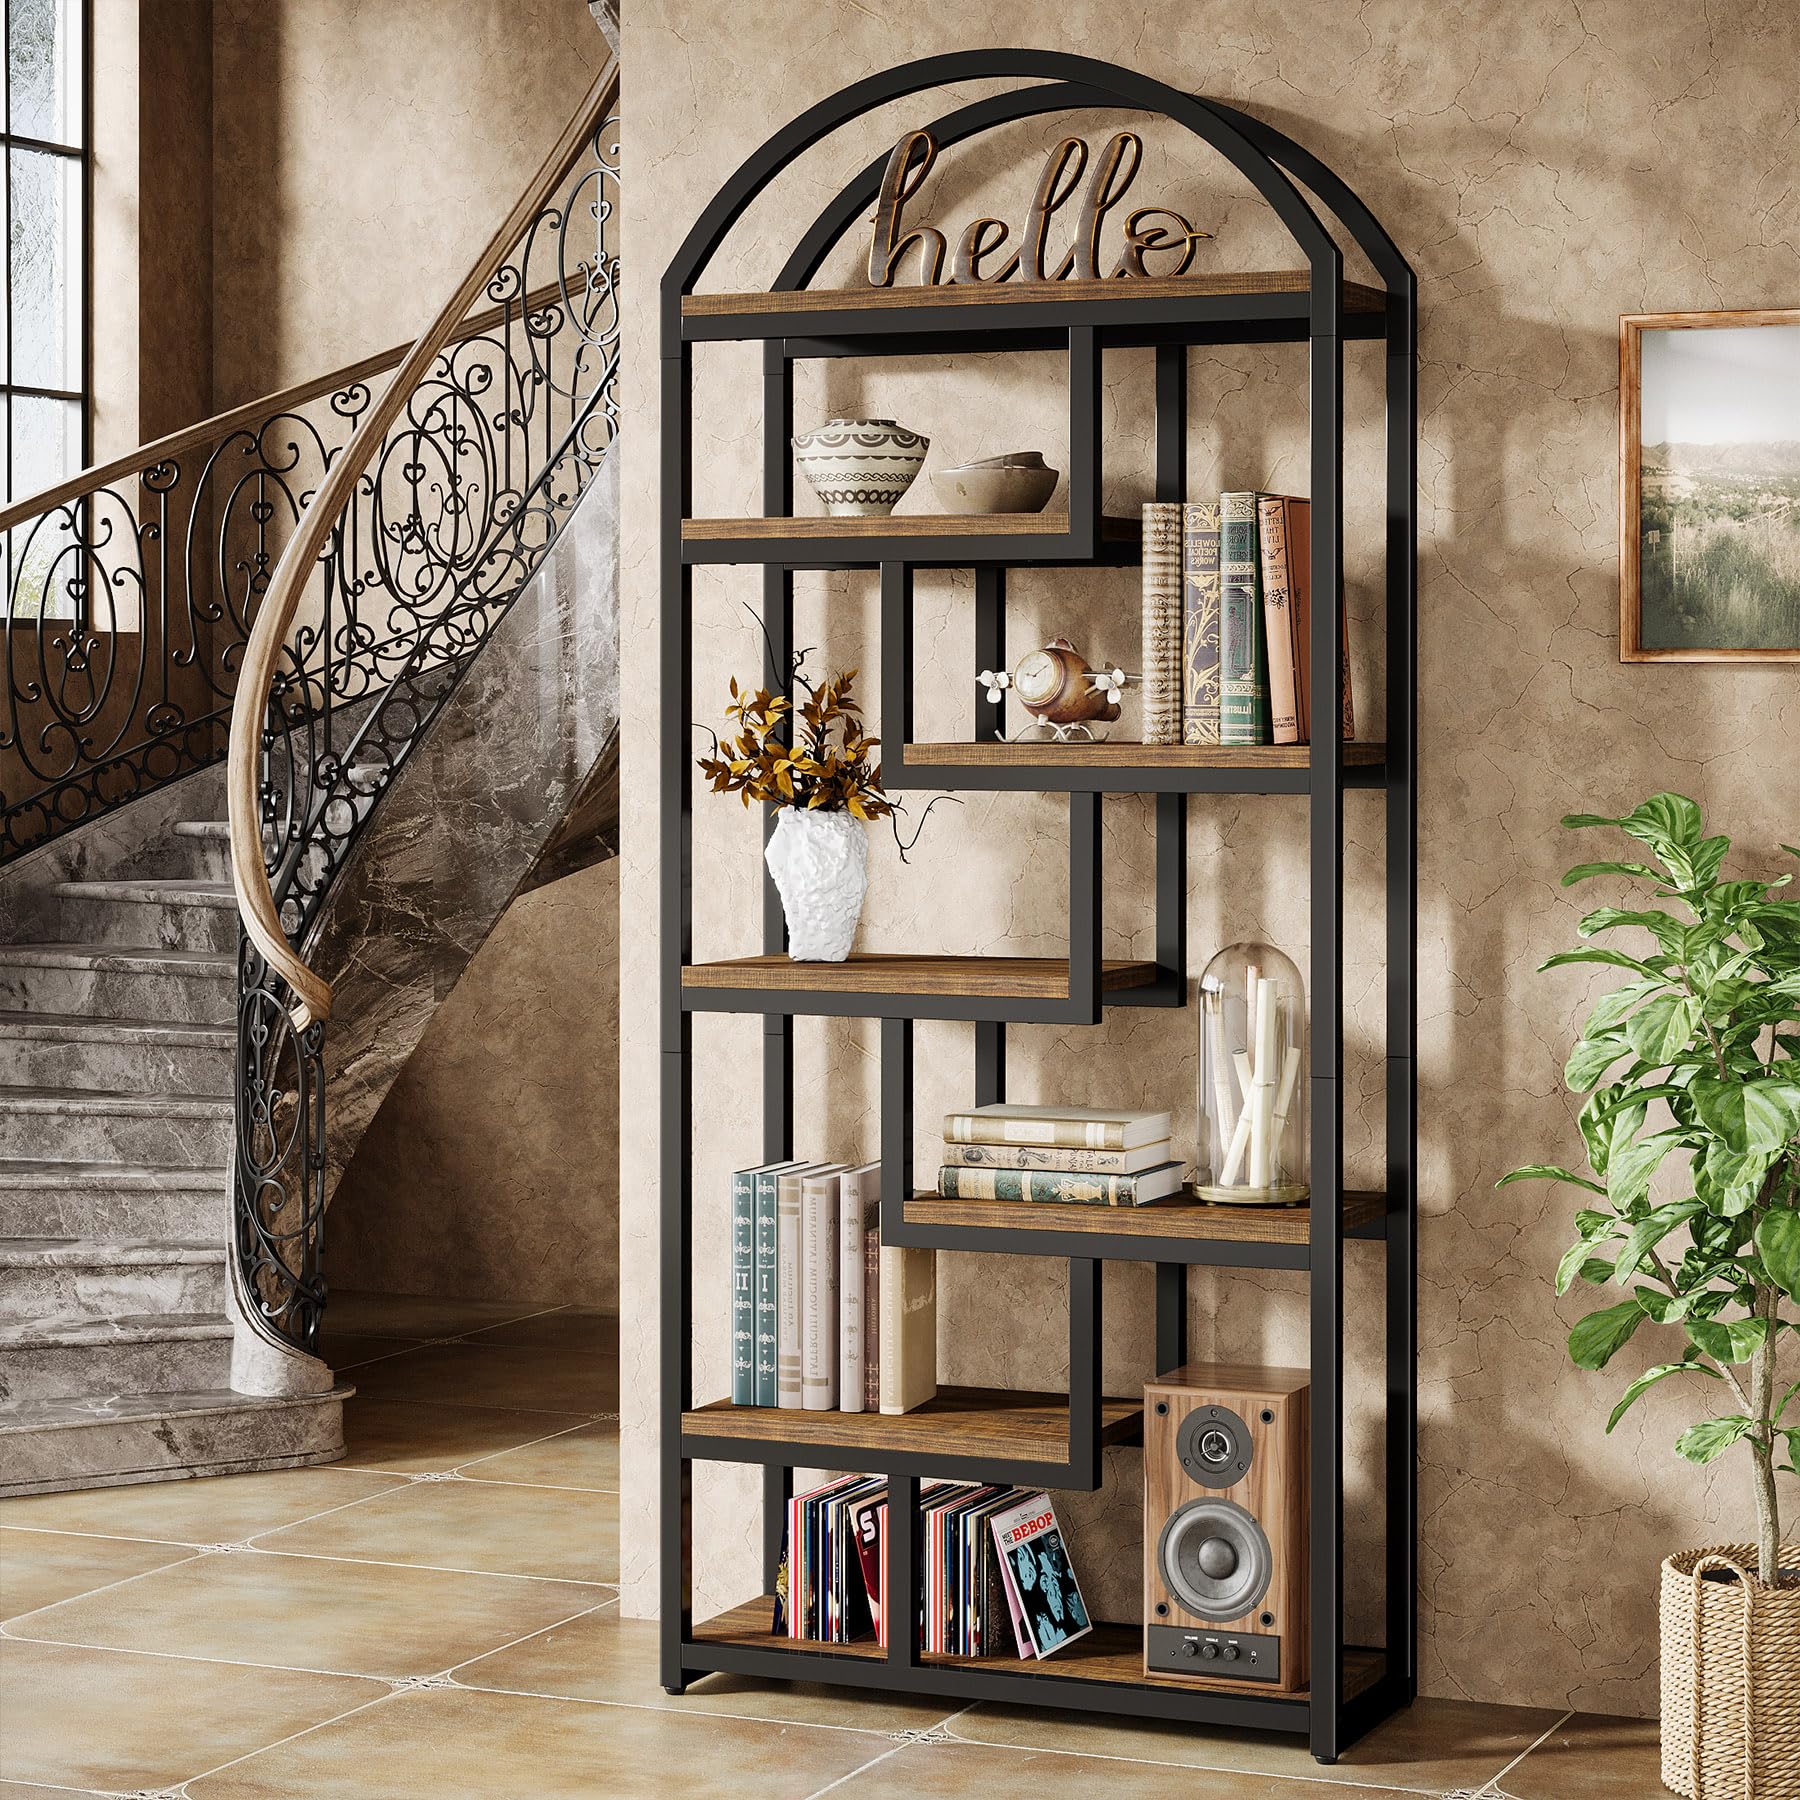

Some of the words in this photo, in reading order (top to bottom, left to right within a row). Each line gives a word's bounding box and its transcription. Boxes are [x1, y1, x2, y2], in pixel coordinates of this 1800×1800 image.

[868, 130, 1213, 287] hello
[736, 1273, 749, 1291] II
[1012, 1511, 1053, 1542] BEBOP
